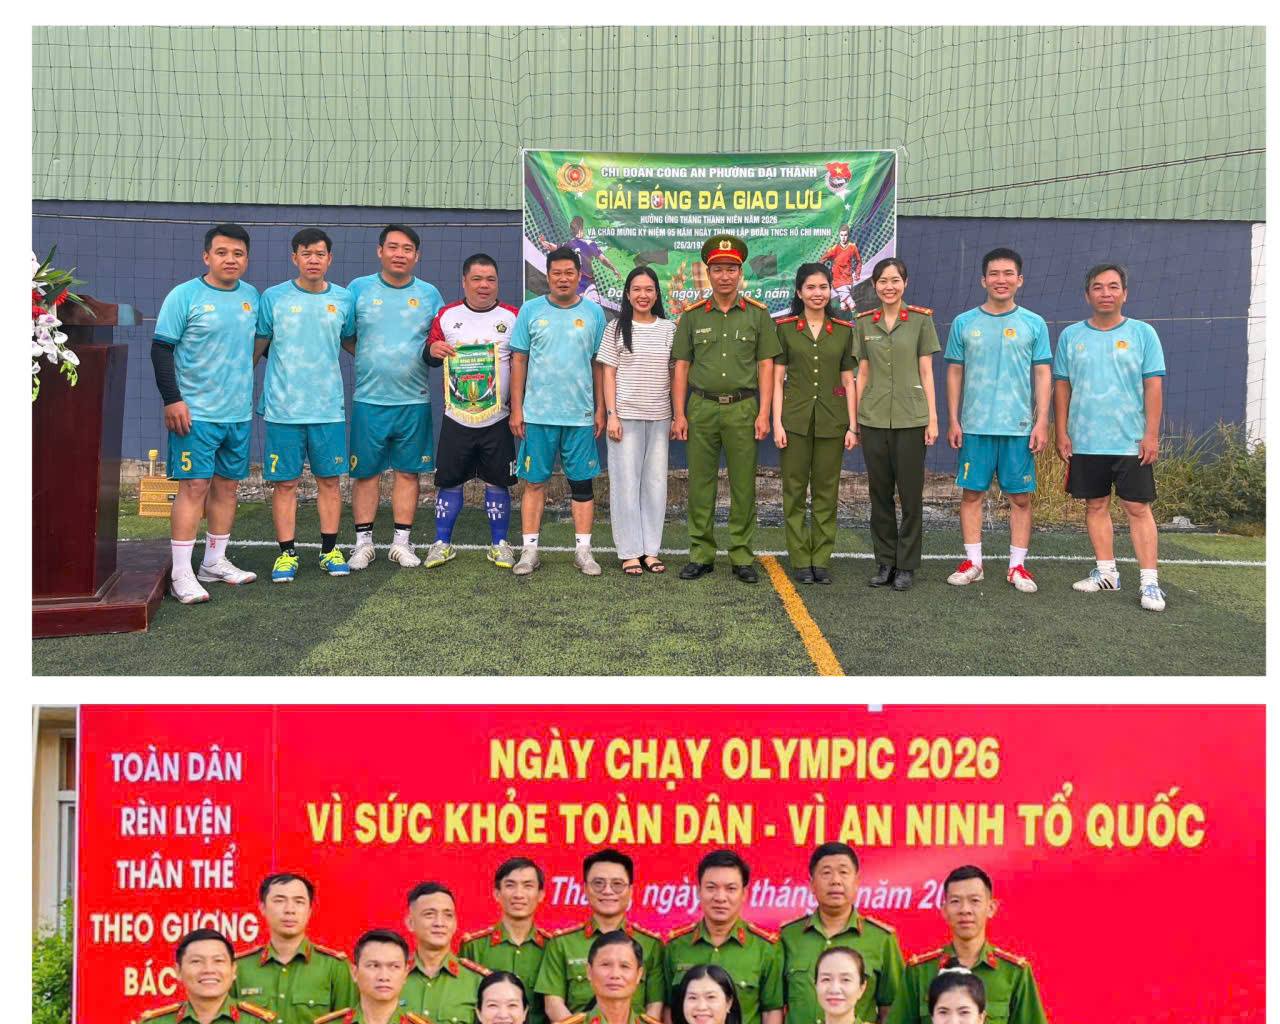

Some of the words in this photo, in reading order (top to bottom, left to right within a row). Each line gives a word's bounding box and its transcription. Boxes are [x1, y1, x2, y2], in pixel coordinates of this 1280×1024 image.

[601, 167, 620, 178] CHI
[690, 167, 706, 178] AN
[596, 183, 632, 210] GIẢI
[638, 183, 692, 210] BÓNG
[698, 183, 726, 210] ĐÁ
[733, 190, 778, 210] GIAO
[785, 189, 822, 210] LƯU
[761, 215, 778, 224] 2026
[813, 227, 831, 237] MINH
[672, 288, 700, 300] ngày
[755, 288, 761, 297] 3
[765, 287, 790, 298] năm
[181, 451, 193, 472] 5
[270, 453, 279, 473] 7
[111, 744, 180, 783] TOÀN
[187, 744, 242, 782] DÂN
[490, 727, 594, 780] NGÀY
[605, 737, 711, 790] CHẠY
[722, 737, 896, 780] OLYMPIC
[907, 736, 1000, 780] 2026
[120, 797, 167, 836] RÈN
[175, 797, 232, 844] LYỆN
[307, 791, 343, 843] VÌ
[354, 792, 433, 844] SỨC
[445, 787, 548, 844] KHỎE
[559, 793, 662, 844] TOÀN
[675, 792, 752, 845] DÂN
[788, 792, 826, 845] VÌ
[839, 803, 892, 846] AN
[905, 803, 1004, 846] NINH
[1018, 781, 1074, 847] TỔ
[1085, 786, 1206, 848] QUỐC
[116, 851, 183, 889] THÂN
[191, 843, 237, 889] THỂ
[643, 876, 701, 914] ngày
[855, 879, 912, 909] năm
[90, 912, 154, 943] THEO
[124, 959, 178, 997] BÁC
